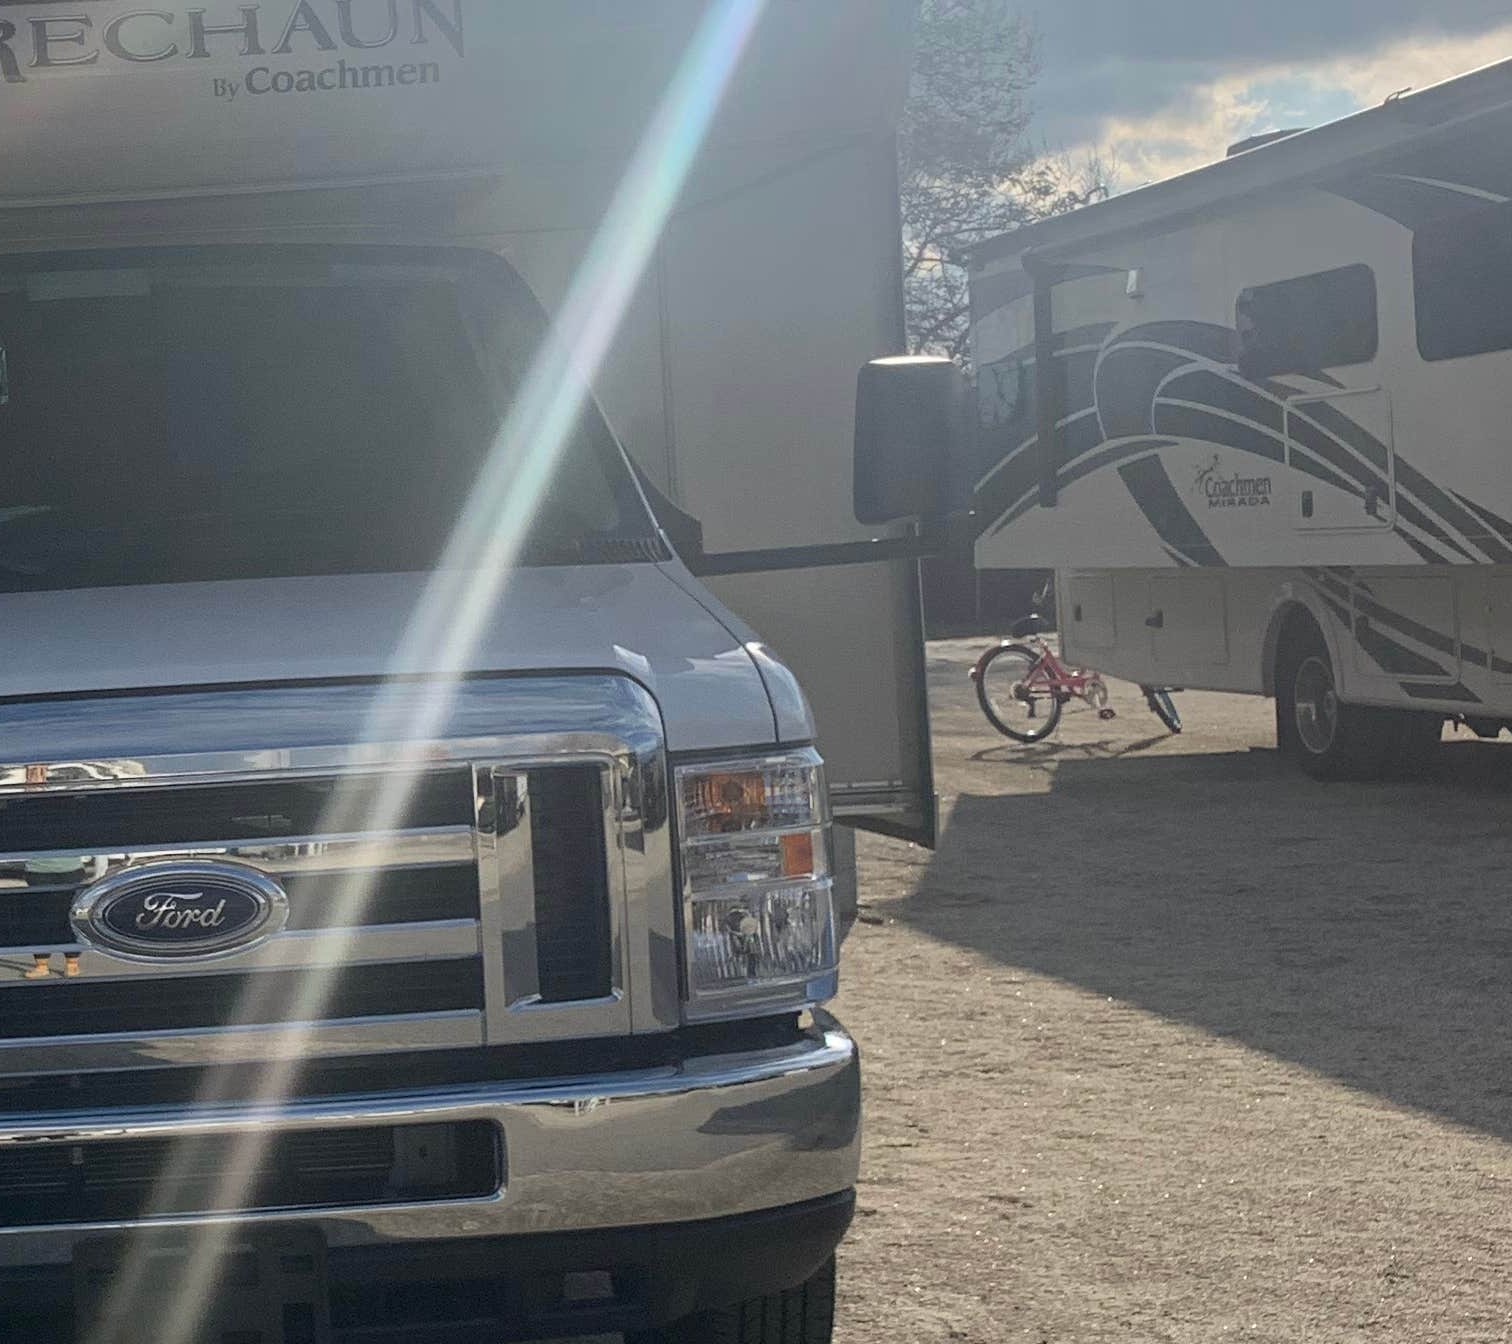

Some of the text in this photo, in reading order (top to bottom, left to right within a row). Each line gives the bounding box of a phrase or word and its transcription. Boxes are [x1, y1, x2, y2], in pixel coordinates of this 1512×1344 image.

[212, 59, 441, 102] By Coachmen
[1204, 472, 1272, 498] Coachmen
[136, 892, 226, 930] Ford
